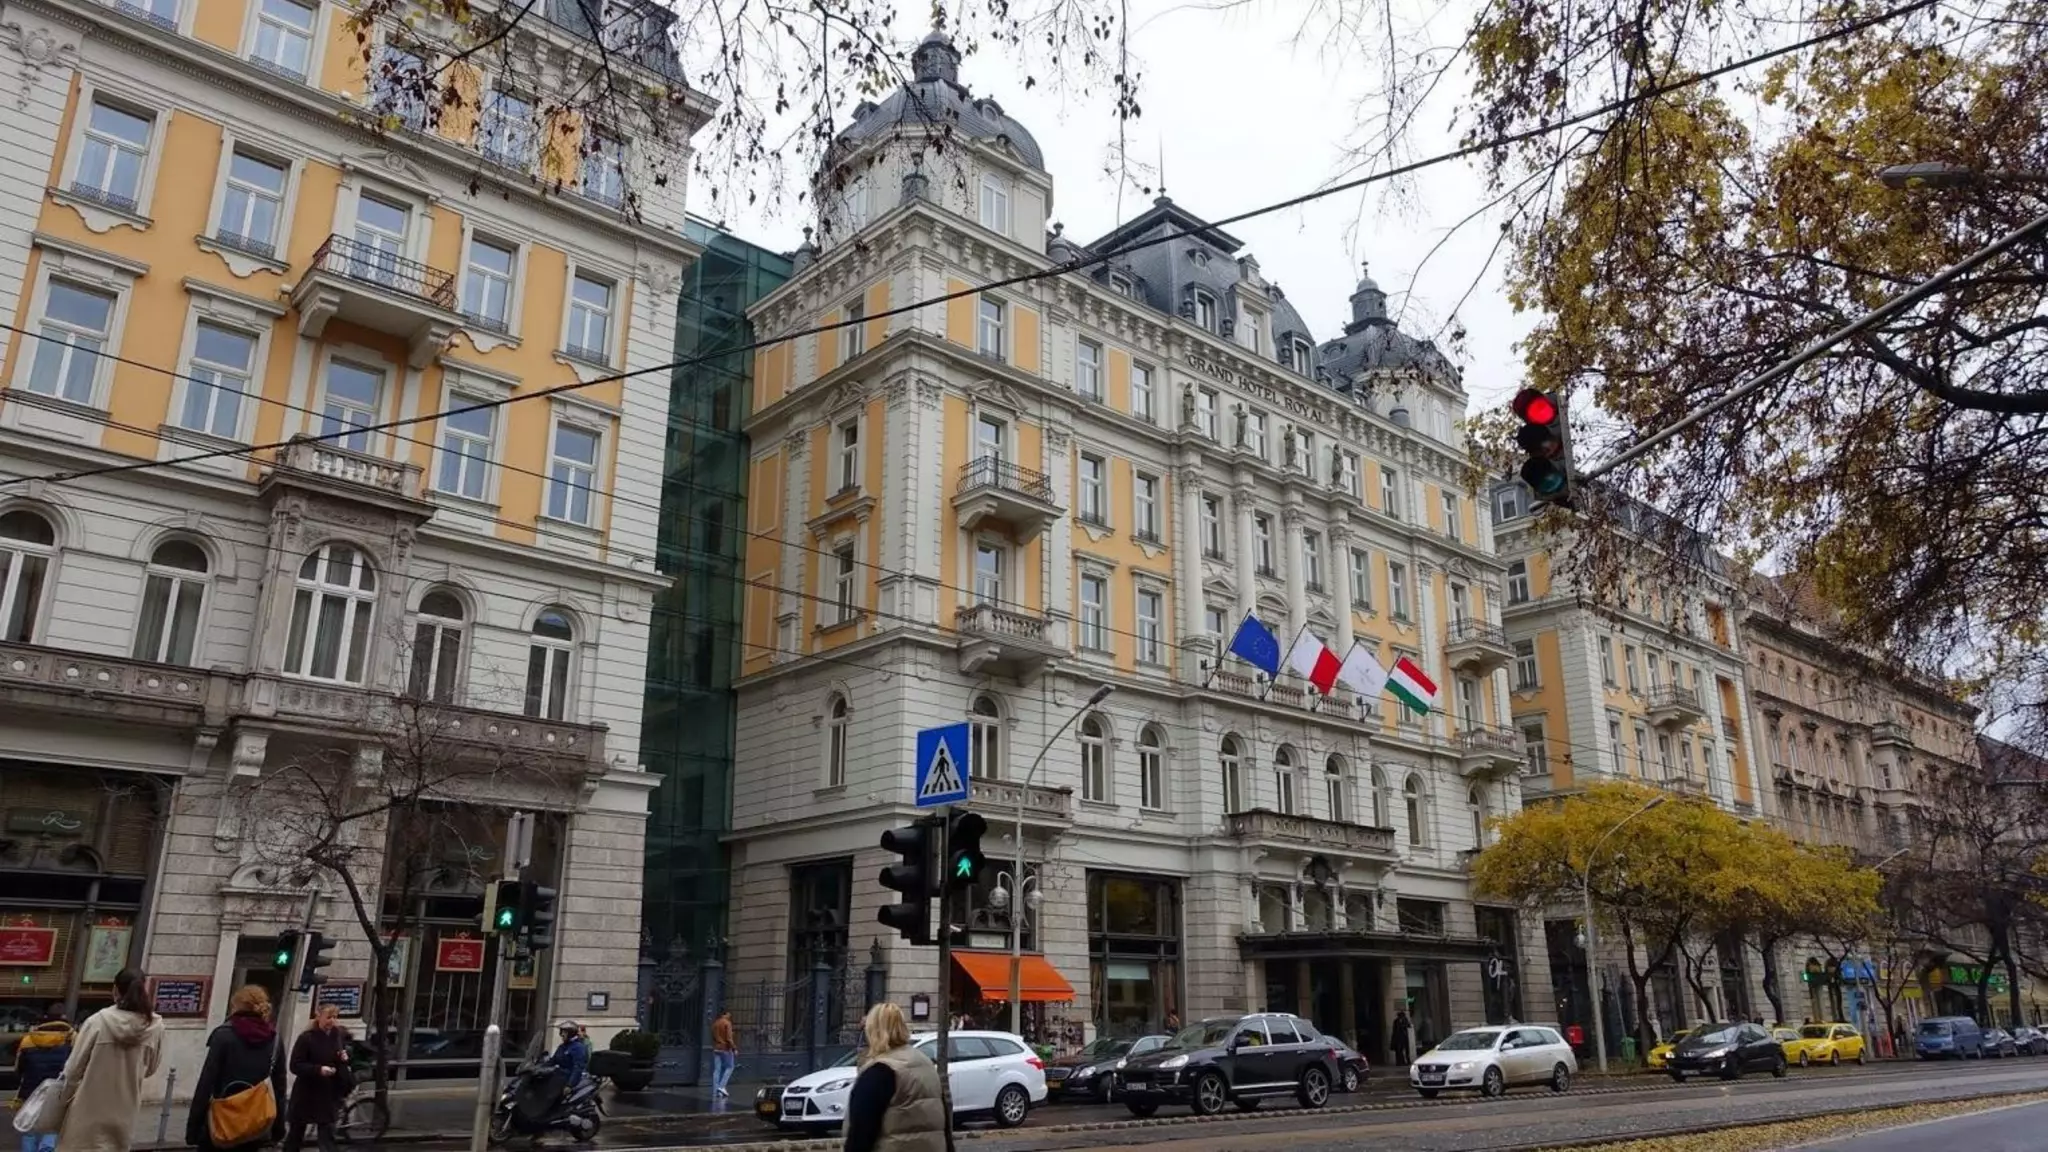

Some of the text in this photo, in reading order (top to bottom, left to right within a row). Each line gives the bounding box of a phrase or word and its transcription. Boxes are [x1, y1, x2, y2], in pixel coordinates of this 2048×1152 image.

[1188, 355, 1326, 424] GRAND HOTEL ROYAL
